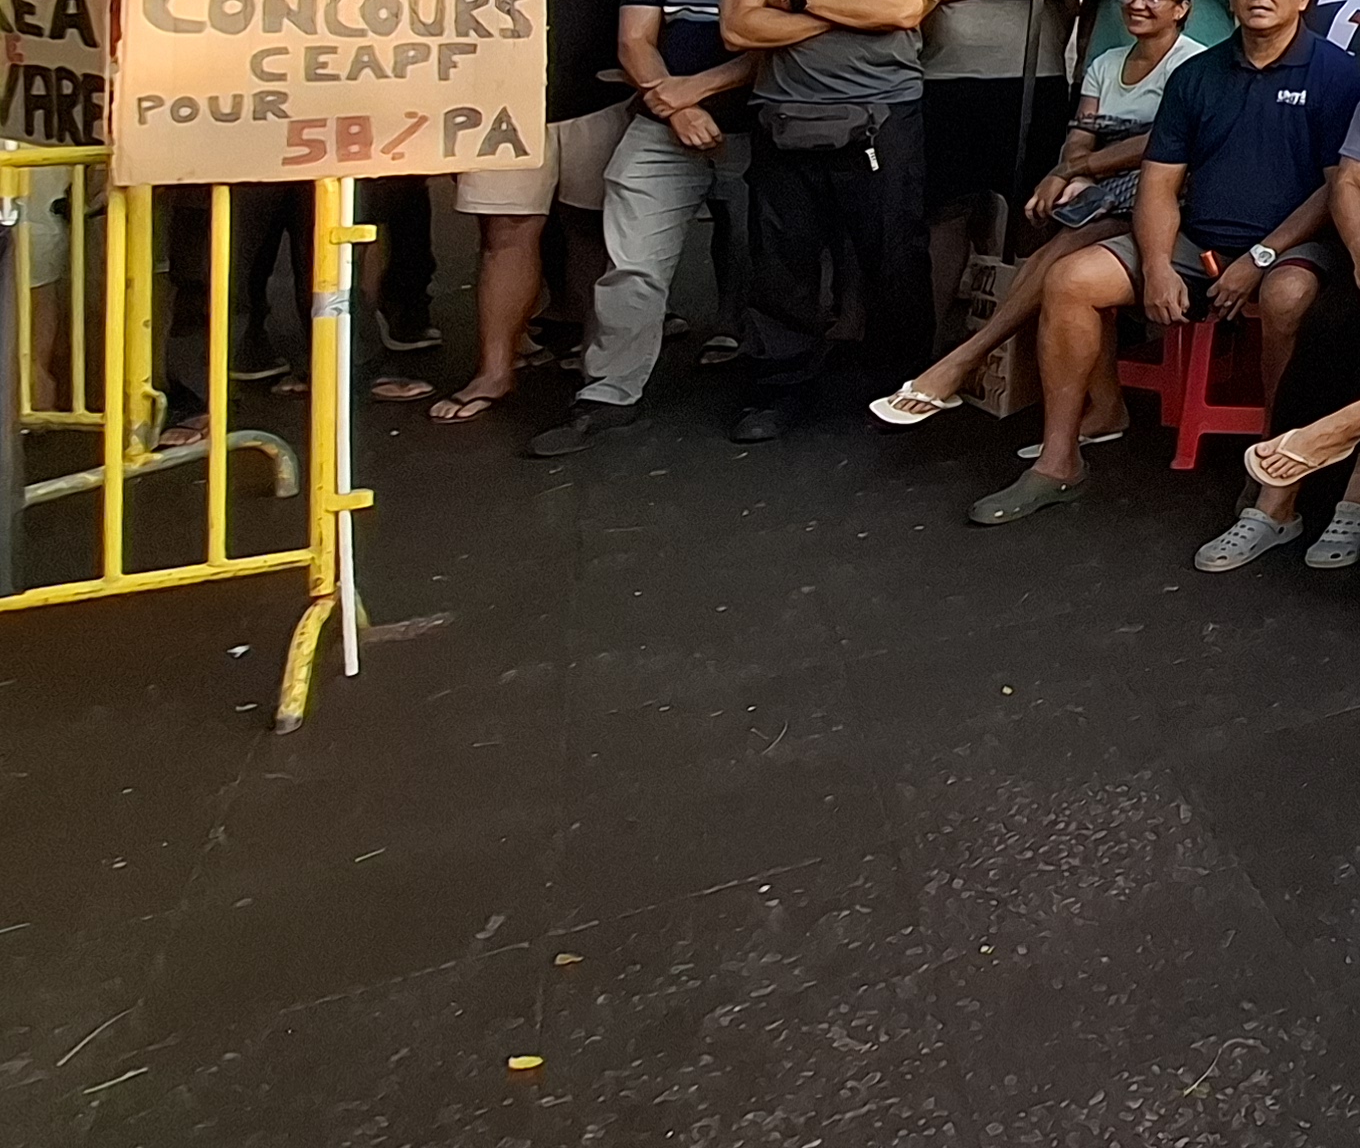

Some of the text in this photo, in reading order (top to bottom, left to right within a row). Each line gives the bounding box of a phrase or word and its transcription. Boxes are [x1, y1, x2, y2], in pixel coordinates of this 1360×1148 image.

[249, 42, 479, 84] CEAPF
[137, 89, 292, 125] POUR
[443, 106, 531, 158] PA
